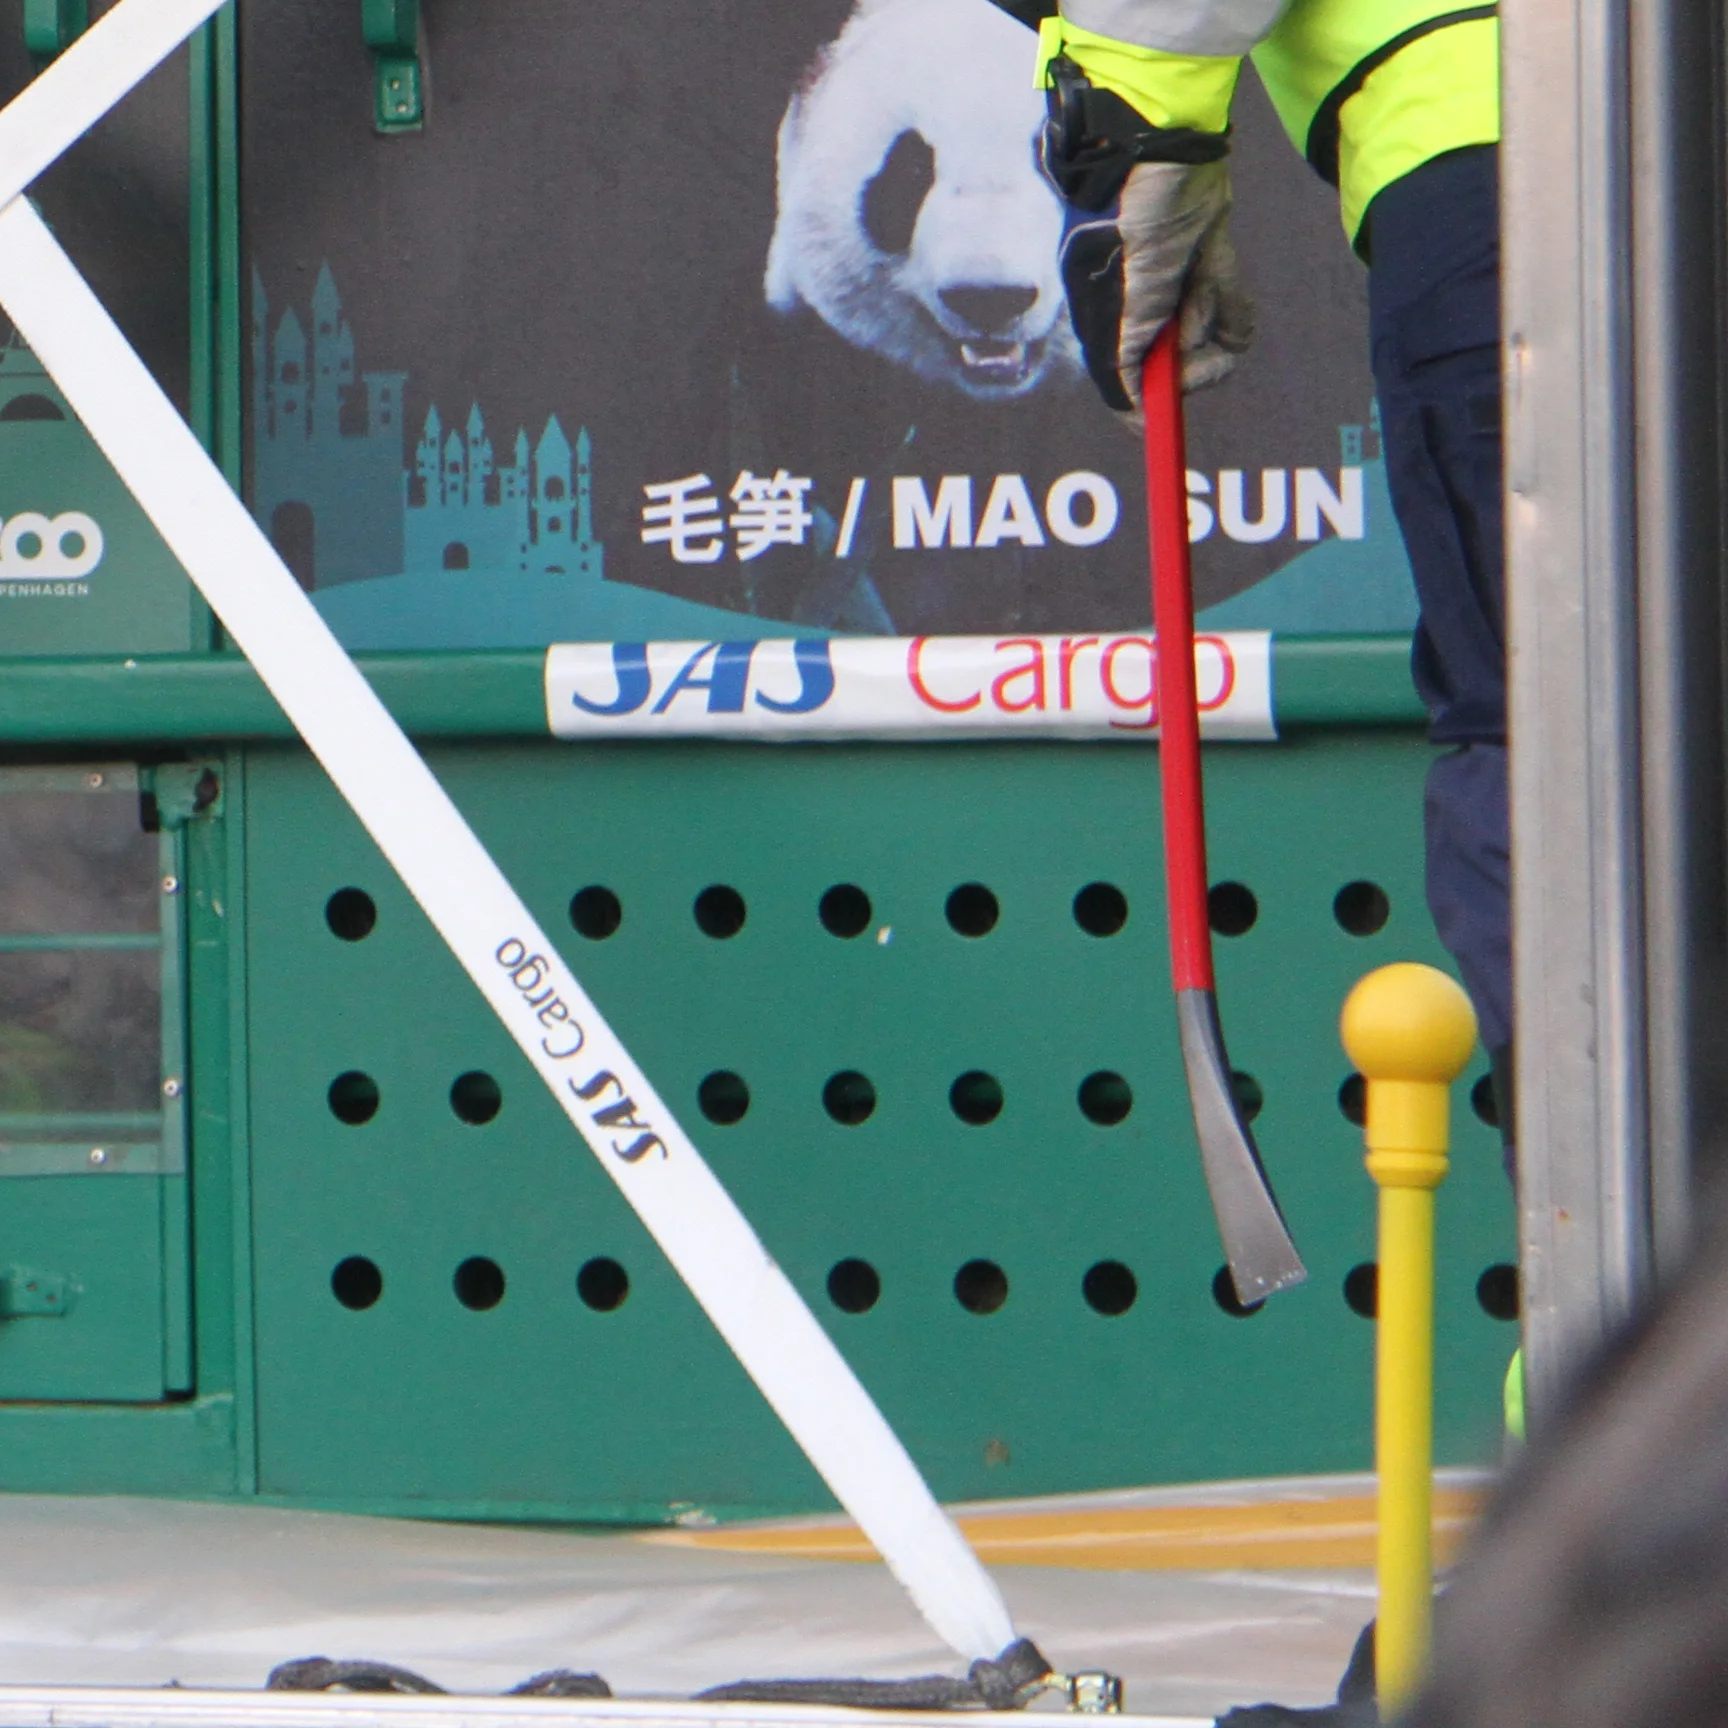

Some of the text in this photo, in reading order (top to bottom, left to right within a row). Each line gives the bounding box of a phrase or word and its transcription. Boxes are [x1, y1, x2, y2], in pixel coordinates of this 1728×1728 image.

[640, 468, 813, 563] 毛笋
[834, 478, 866, 559] /
[891, 471, 1120, 549] MAO
[905, 634, 1236, 730] Cargo
[495, 937, 669, 1163] SAS Cargo
